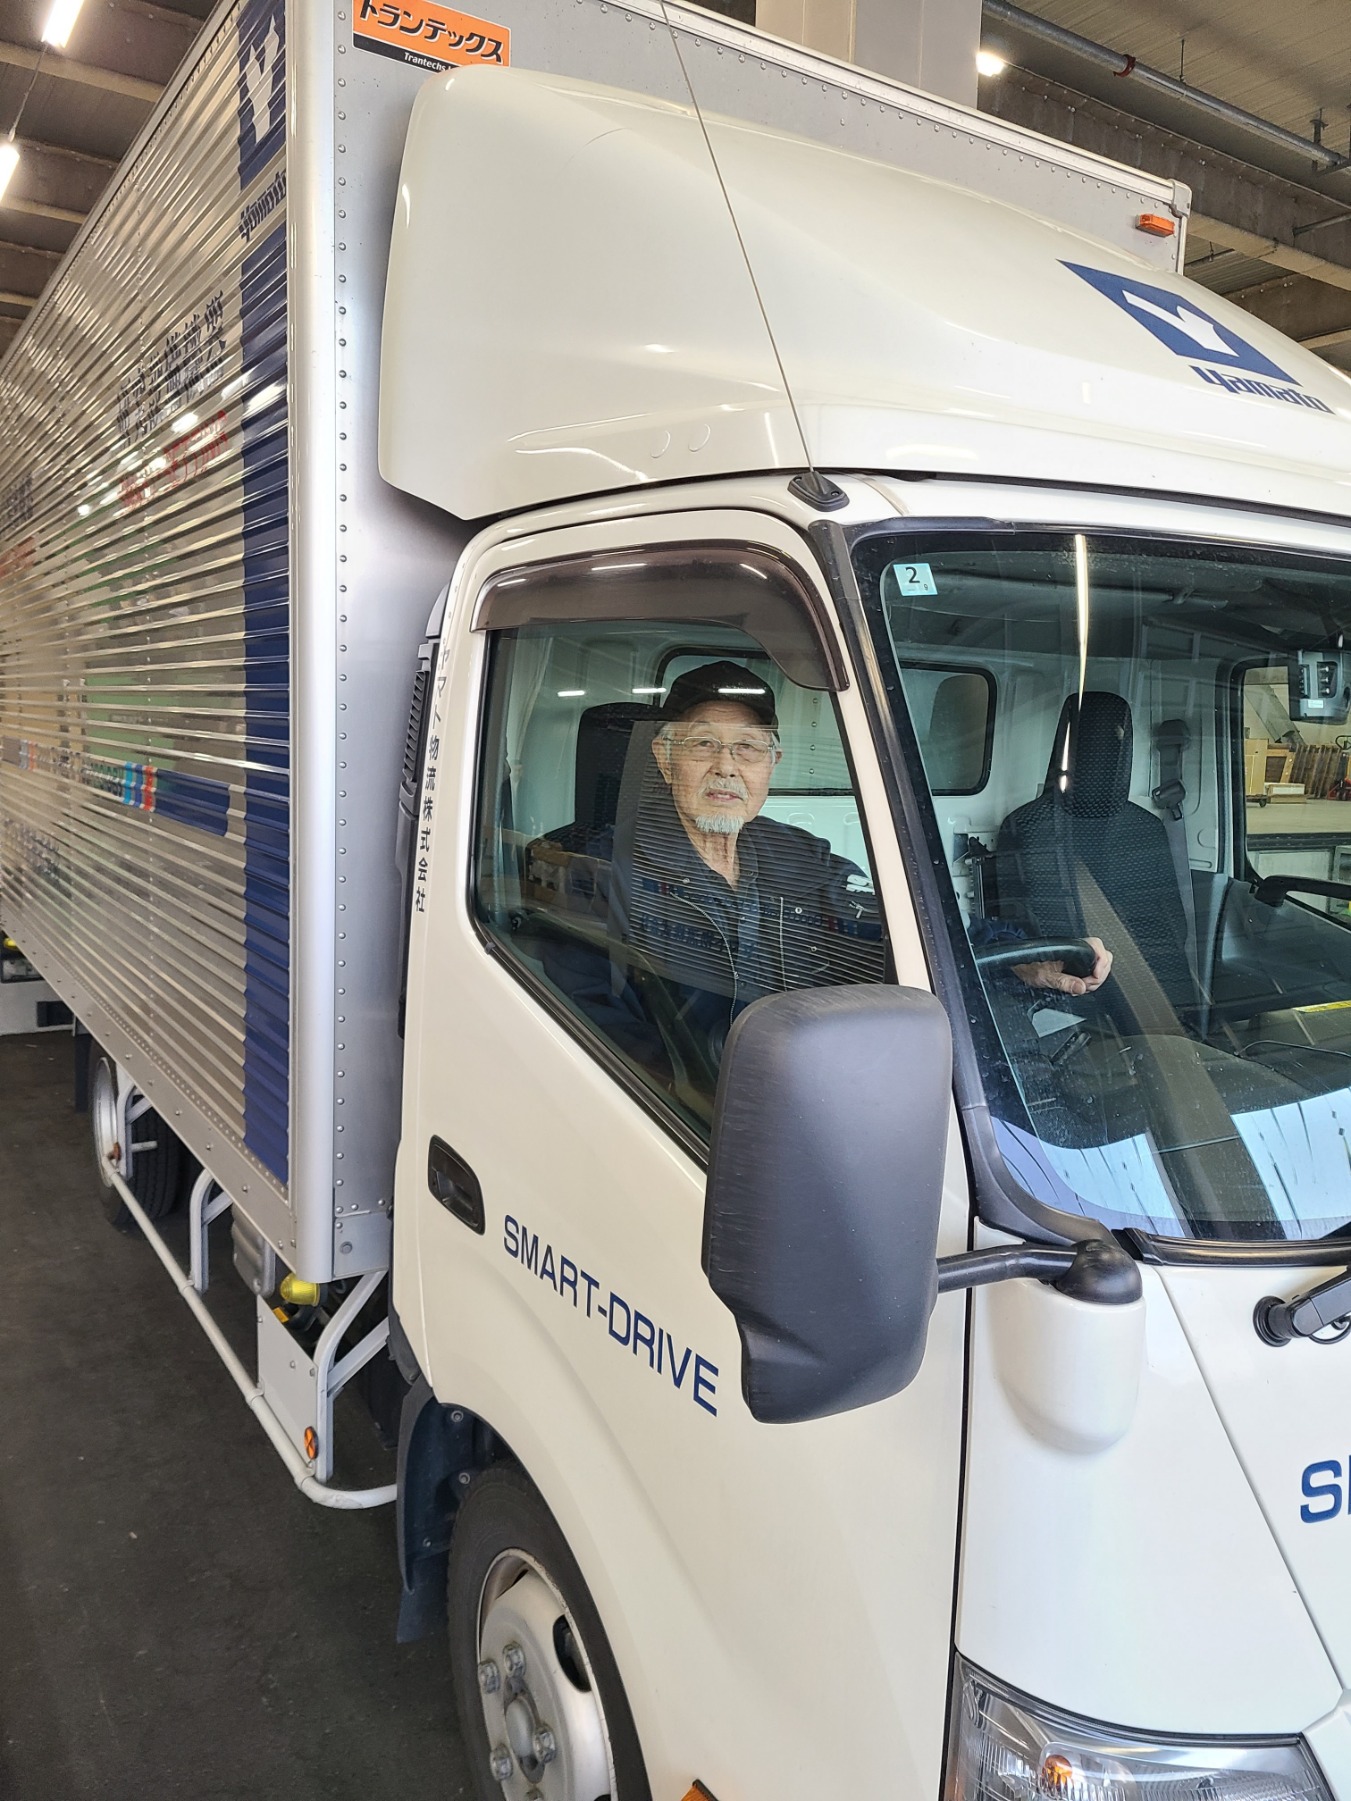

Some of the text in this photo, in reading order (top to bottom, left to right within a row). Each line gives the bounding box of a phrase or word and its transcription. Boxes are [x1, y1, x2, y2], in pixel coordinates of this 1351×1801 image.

[360, 0, 503, 64] トランテックス
[404, 52, 446, 71] Trantechs
[1188, 364, 1336, 415] Yamato
[905, 566, 921, 584] 2
[415, 646, 450, 913] ヤマト物流株式会社
[504, 1214, 719, 1417] SMART-DRIVE
[1300, 1454, 1351, 1524] S
